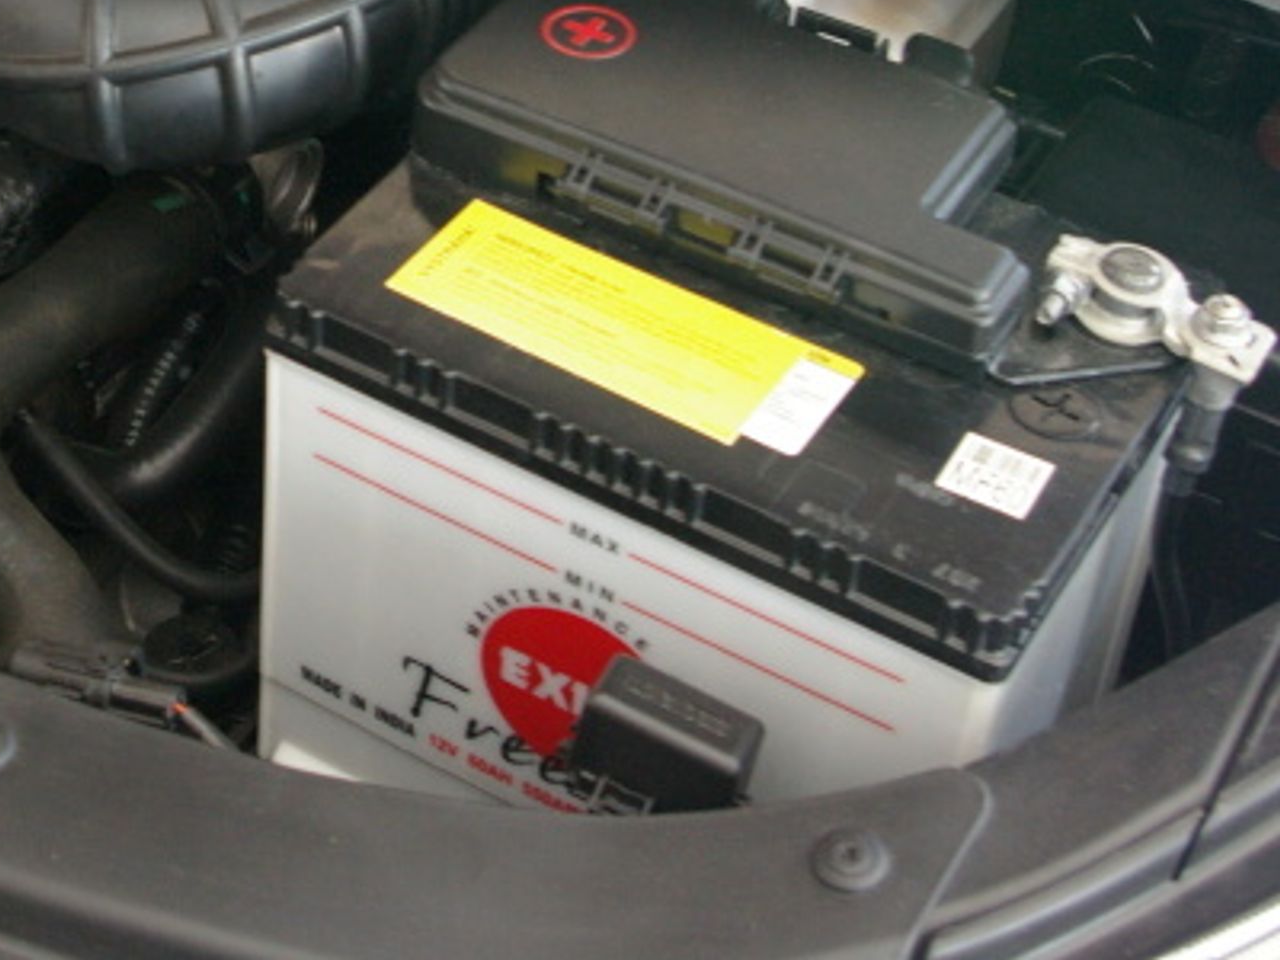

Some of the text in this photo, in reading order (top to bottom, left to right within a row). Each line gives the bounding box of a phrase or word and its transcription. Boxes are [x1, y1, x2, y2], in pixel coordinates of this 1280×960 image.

[569, 521, 620, 556] MAX
[565, 569, 615, 603] MIN
[465, 587, 649, 650] MAINTENANCE
[300, 663, 343, 700] MADE
[349, 691, 367, 712] IN
[373, 704, 416, 738] INDIA
[499, 645, 590, 717] EXI
